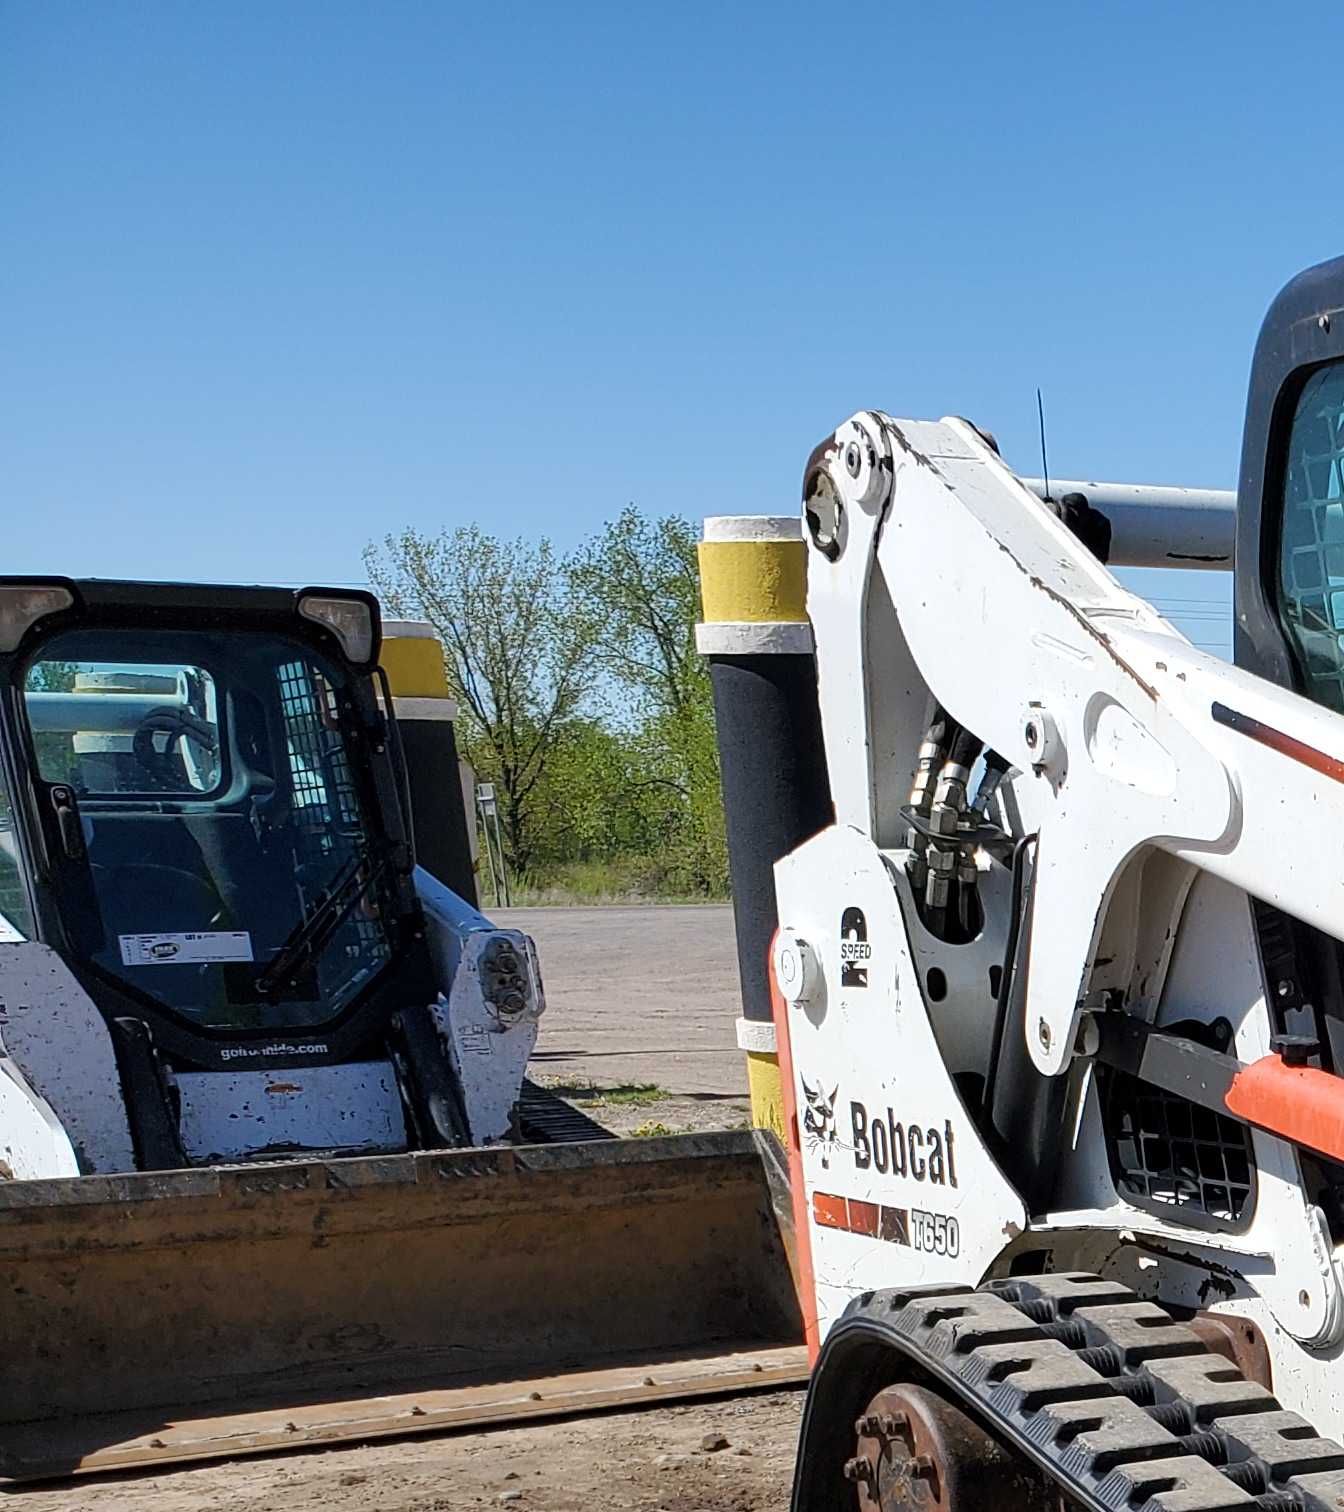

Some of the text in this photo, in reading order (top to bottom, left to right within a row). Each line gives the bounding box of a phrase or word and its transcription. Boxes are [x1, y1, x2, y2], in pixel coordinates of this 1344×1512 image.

[841, 943, 872, 959] SPEED
[849, 1101, 958, 1189] Bobcat
[912, 1208, 960, 1258] T650
